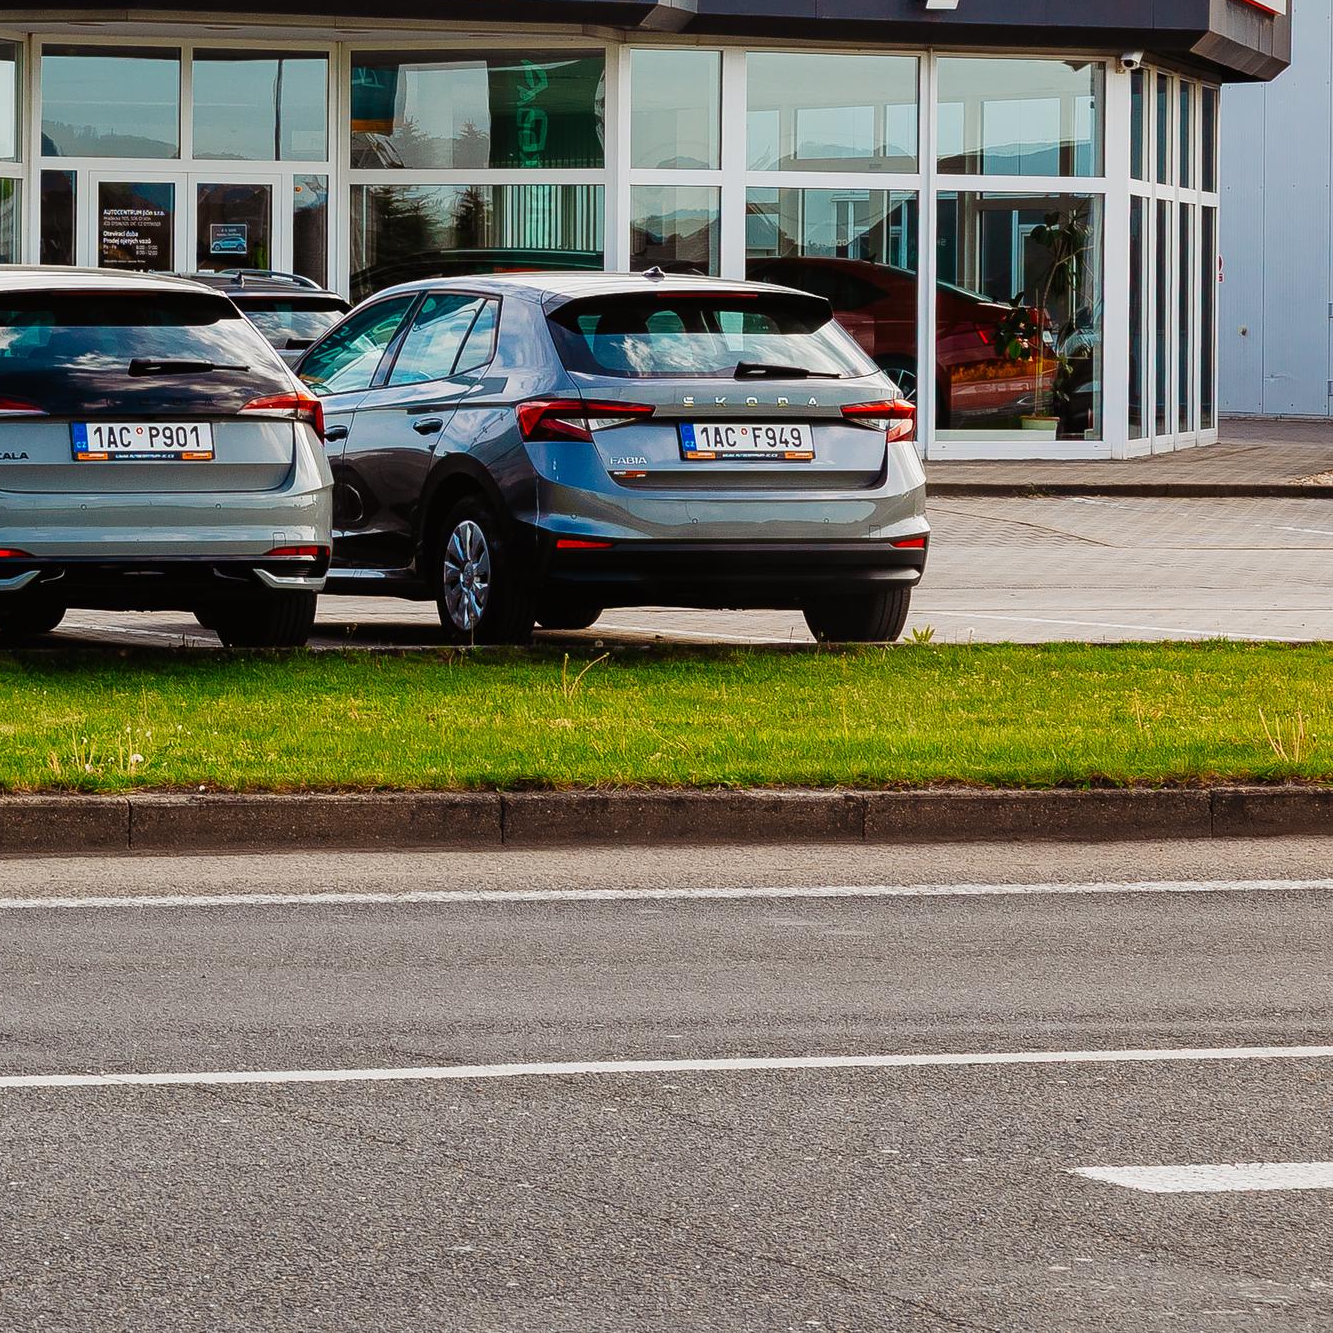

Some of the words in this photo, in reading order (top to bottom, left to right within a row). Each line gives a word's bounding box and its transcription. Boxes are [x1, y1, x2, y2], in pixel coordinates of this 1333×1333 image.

[683, 396, 819, 408] SKODA
[93, 426, 132, 448] 1AC
[148, 425, 201, 448] P901
[700, 426, 737, 448] 1AC
[752, 427, 803, 448] F949
[610, 456, 648, 465] FABIA
